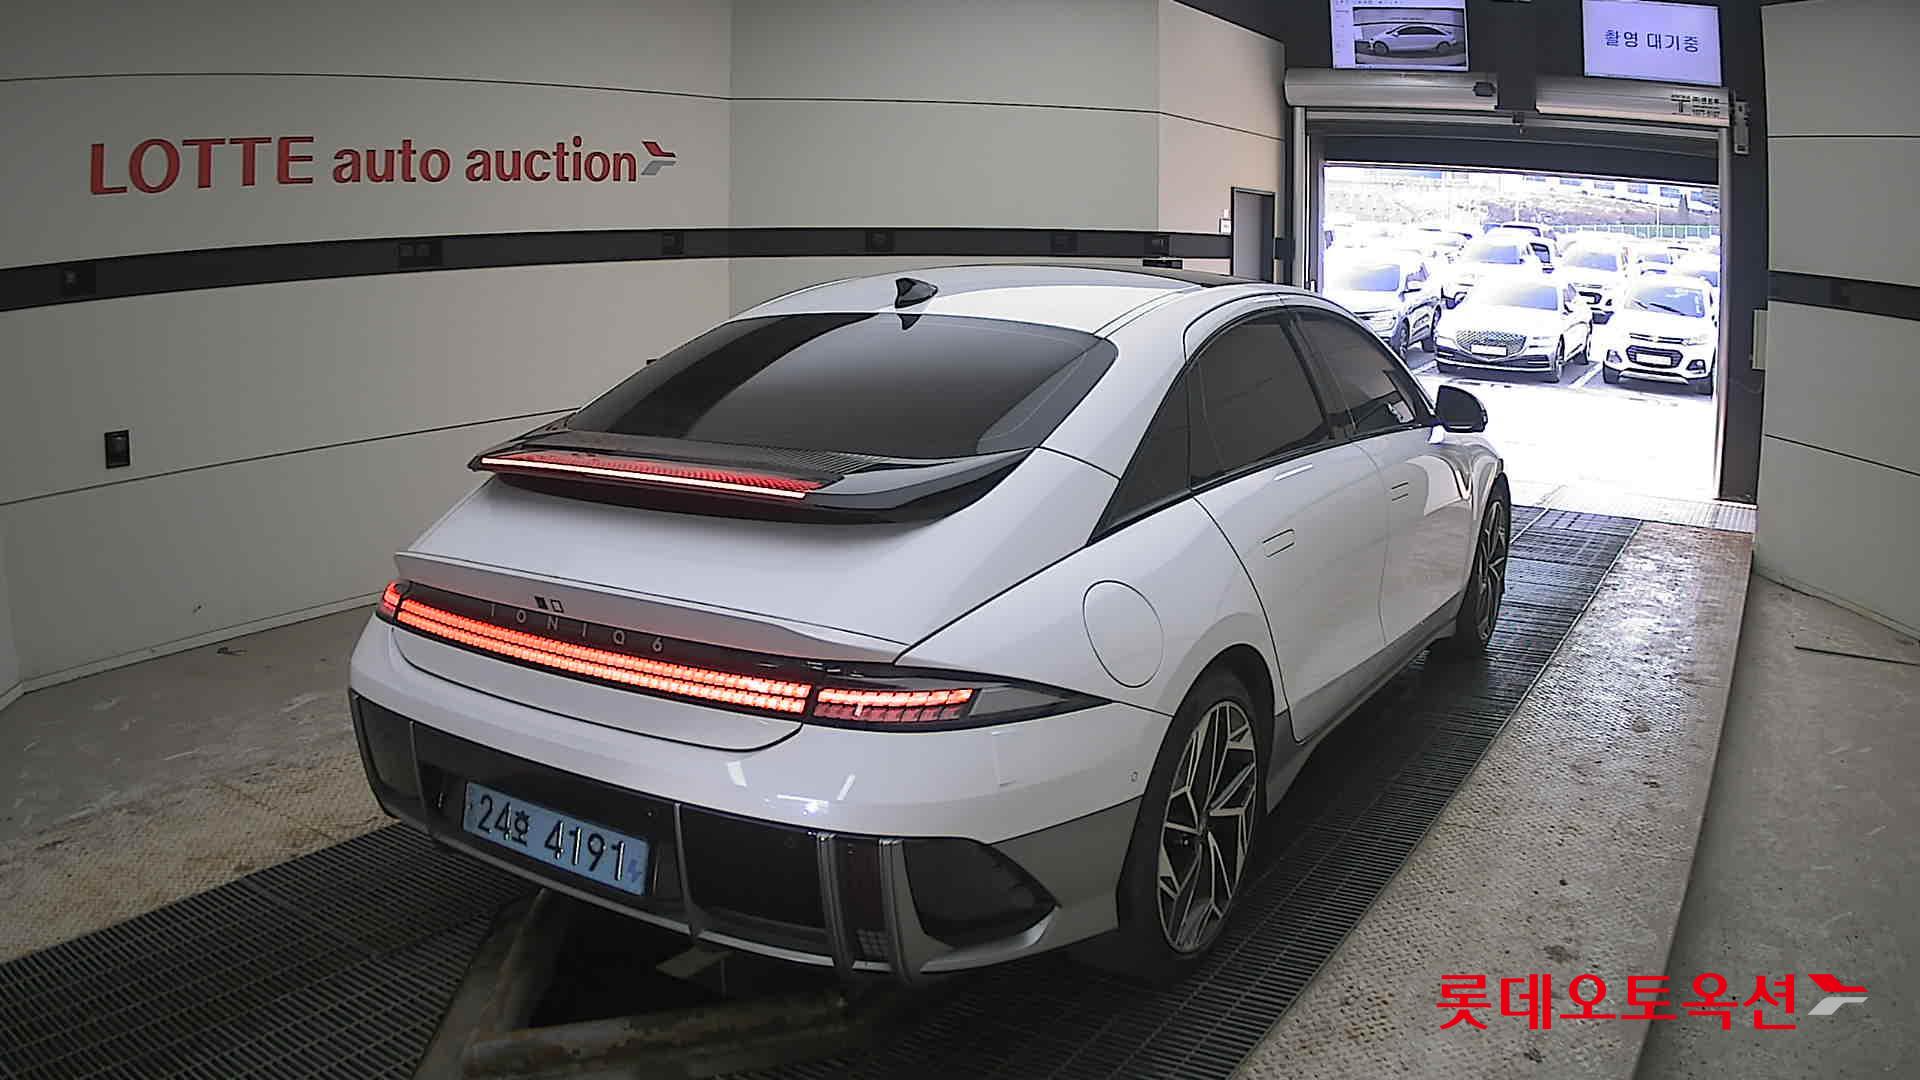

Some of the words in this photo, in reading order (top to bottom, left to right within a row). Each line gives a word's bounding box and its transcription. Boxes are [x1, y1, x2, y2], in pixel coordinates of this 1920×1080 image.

[1605, 29, 1638, 48] 촬영
[1646, 32, 1698, 53] 대기중
[90, 136, 314, 195] LOTTE
[332, 139, 451, 183] auto
[465, 135, 637, 182] auction
[490, 603, 626, 646] IONIQ
[652, 637, 663, 653] 6
[477, 794, 530, 847] 24호
[544, 820, 626, 881] 4191
